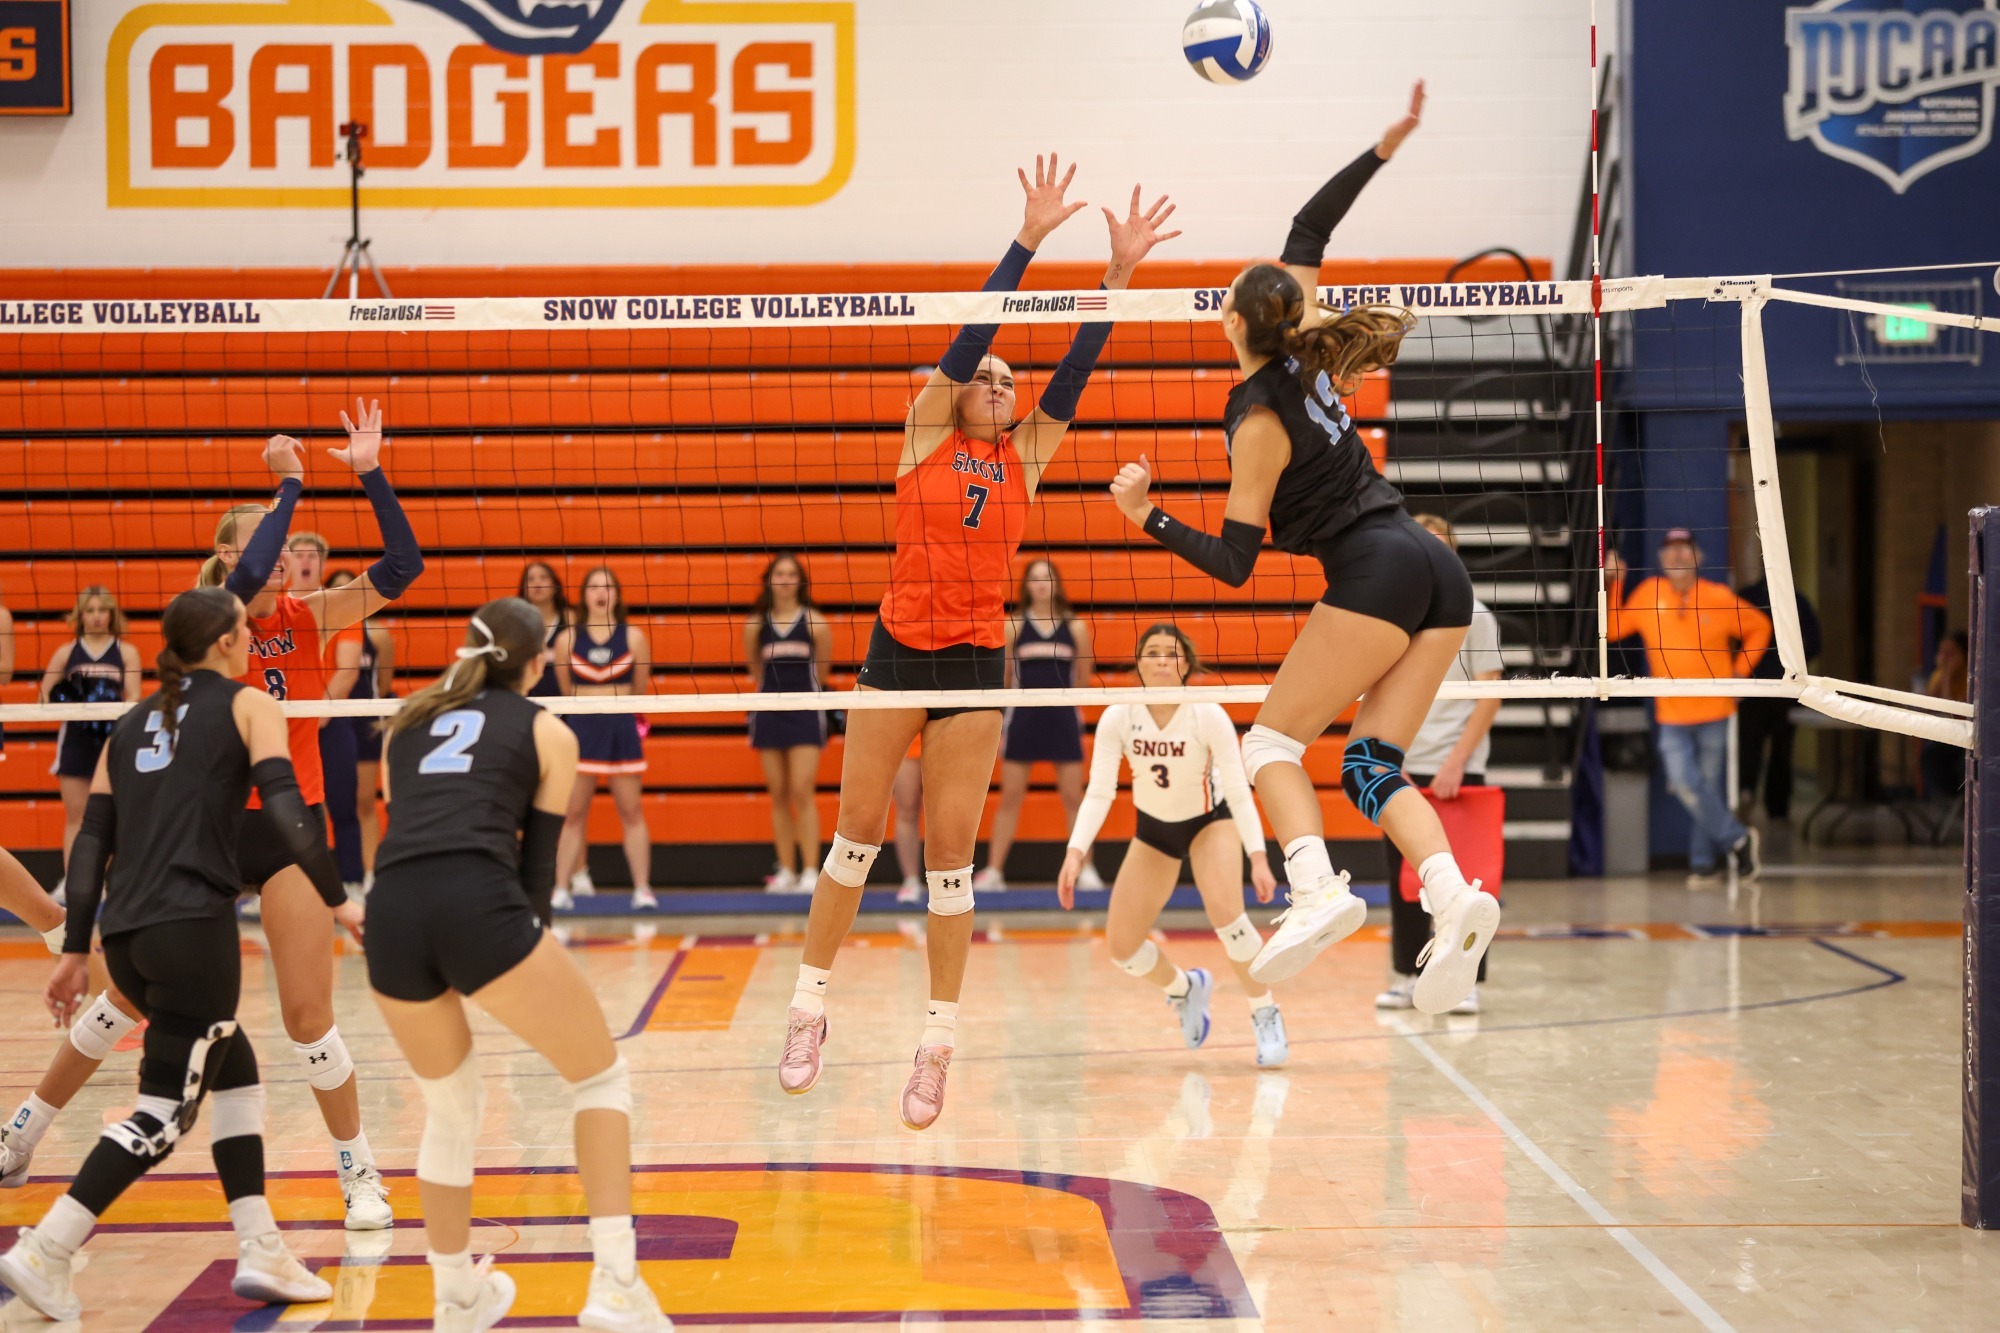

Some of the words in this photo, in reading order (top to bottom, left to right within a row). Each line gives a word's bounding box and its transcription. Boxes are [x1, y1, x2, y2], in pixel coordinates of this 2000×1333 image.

[1799, 18, 1997, 115] NJCAA
[149, 42, 814, 169] BADGERS
[544, 299, 617, 321] SNOW
[627, 297, 741, 320] COLLEGE
[750, 295, 915, 318] VOLLEYBALL
[1002, 296, 1075, 313] FreeTaxUSA
[1194, 289, 1228, 311] SN
[1400, 283, 1563, 308] VOLLEYBALL
[93, 302, 260, 324] VOLLEYBALL
[349, 305, 422, 321] FreeTaxUSA
[951, 450, 1005, 483] SNOW
[962, 483, 989, 530] 7
[264, 667, 288, 701] 8
[135, 703, 190, 773] 3
[418, 709, 486, 775] 2
[1132, 738, 1186, 757] SNOW
[1150, 764, 1170, 789] 3
